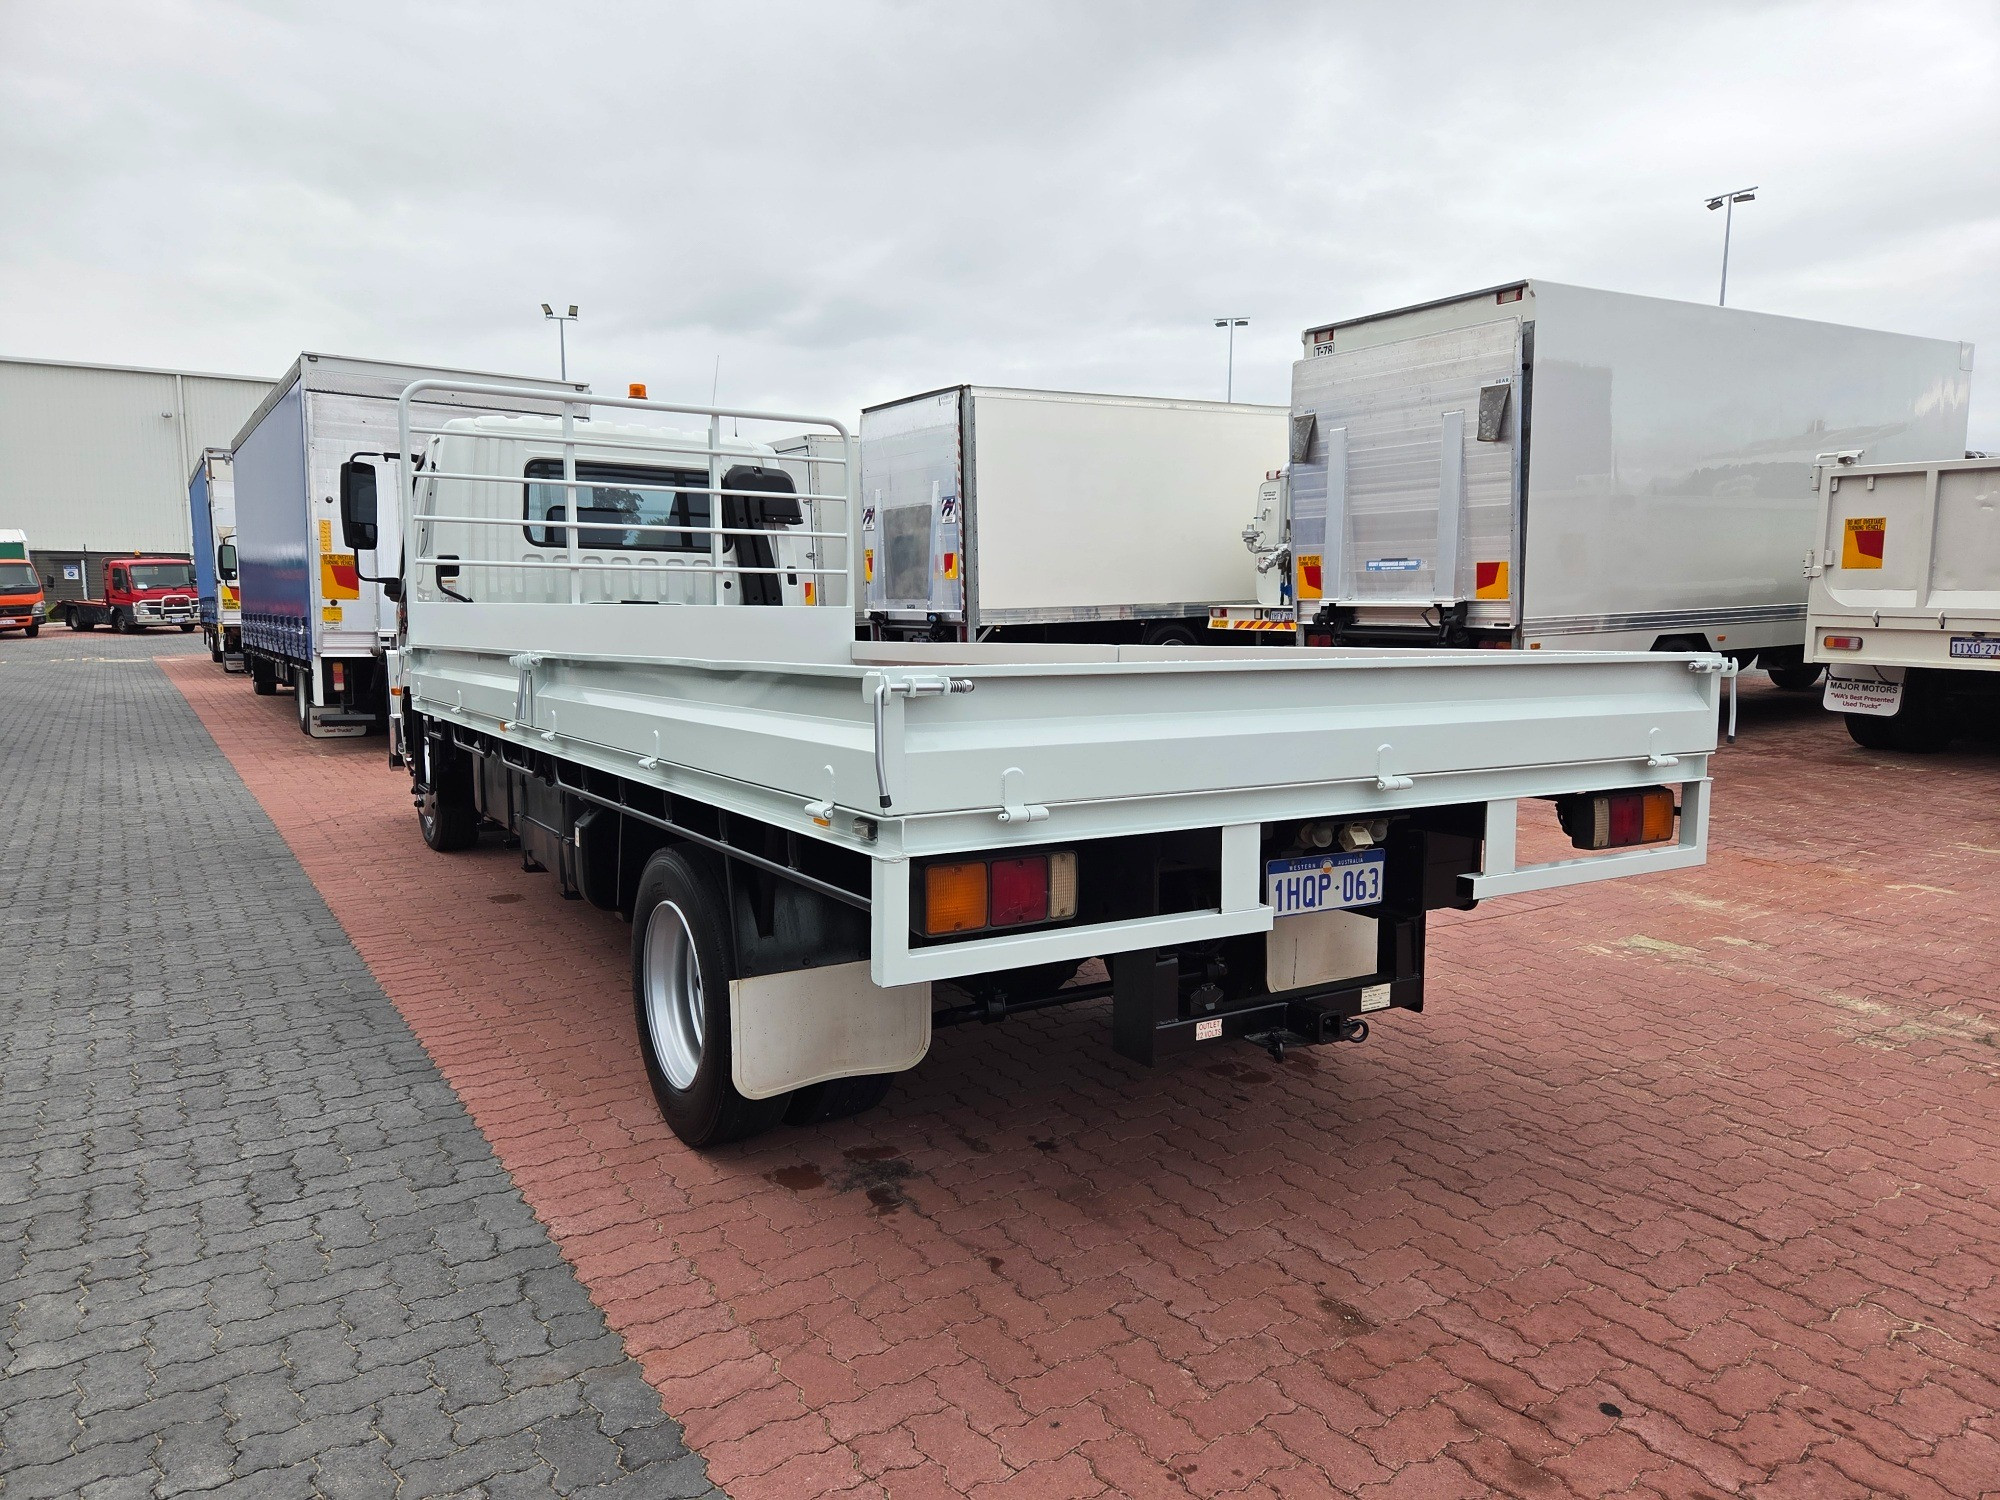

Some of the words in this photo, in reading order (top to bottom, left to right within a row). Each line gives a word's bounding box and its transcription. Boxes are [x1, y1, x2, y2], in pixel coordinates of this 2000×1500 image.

[1830, 682, 1859, 691] MAJOR
[1861, 685, 1898, 694] MOTORS
[1289, 863, 1316, 871] WESTERN
[1337, 857, 1364, 865] AUSTRALIA
[1199, 1021, 1220, 1030] OUTLET
[1205, 1029, 1222, 1038] VOLTS
